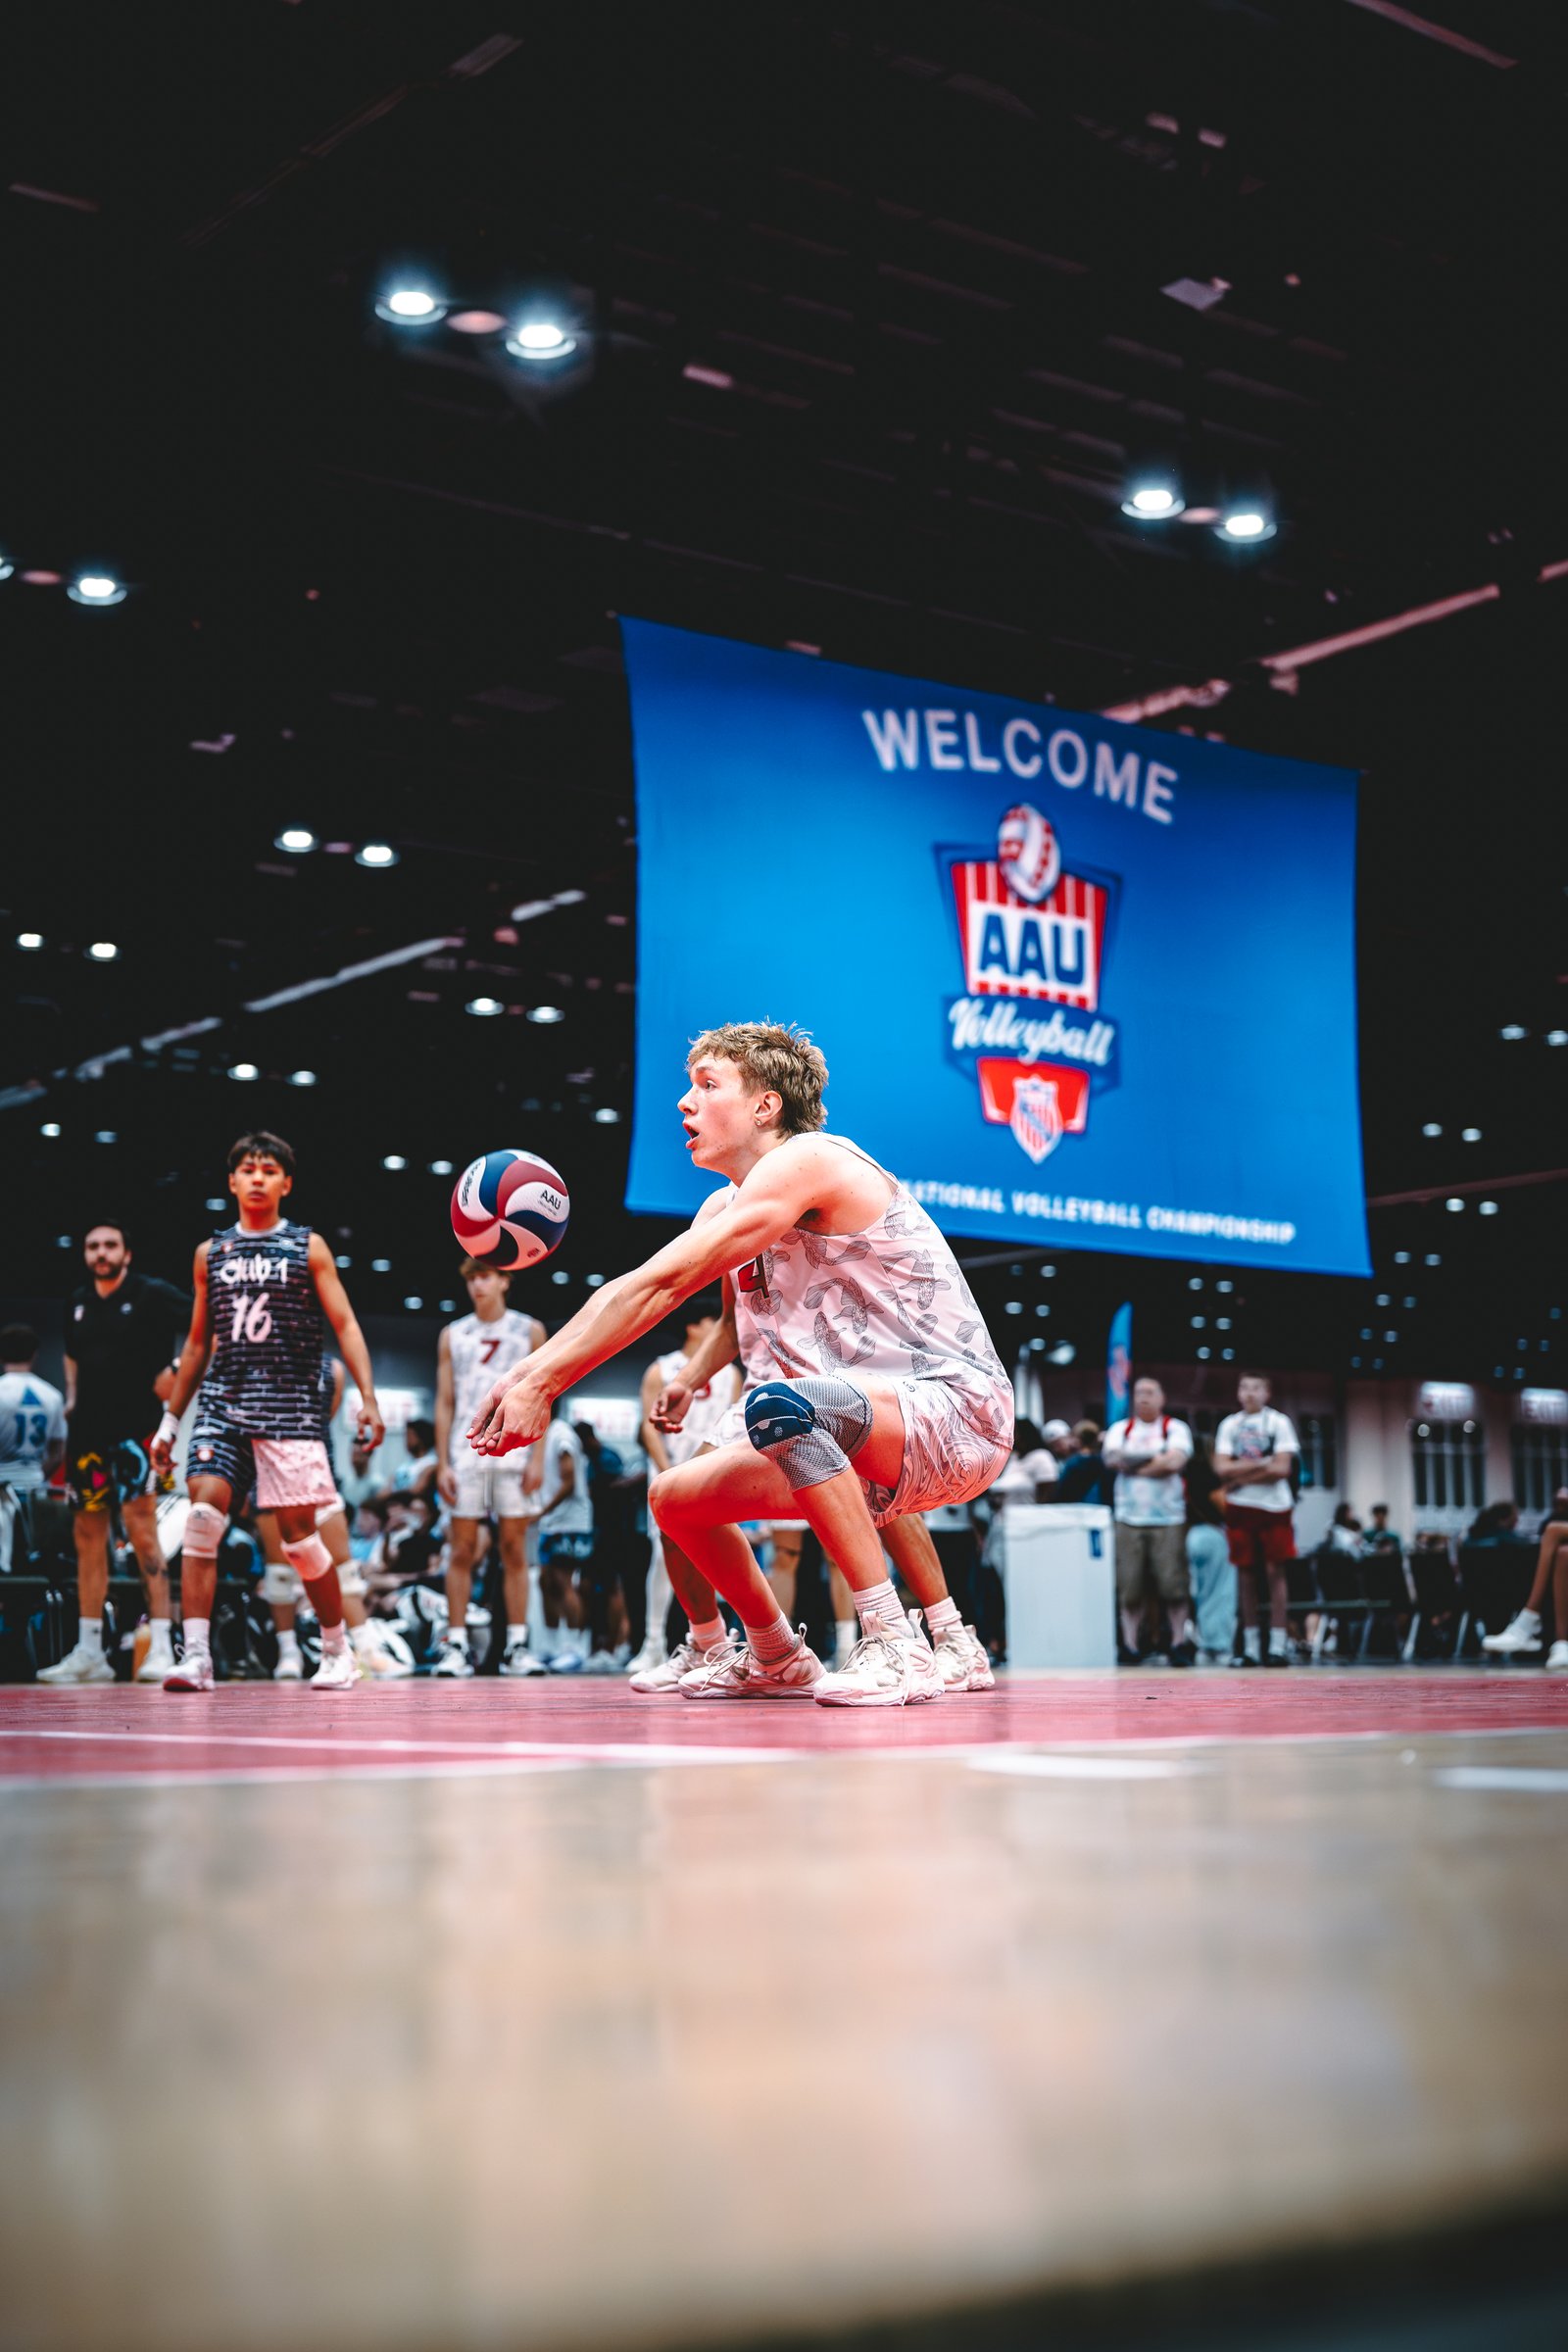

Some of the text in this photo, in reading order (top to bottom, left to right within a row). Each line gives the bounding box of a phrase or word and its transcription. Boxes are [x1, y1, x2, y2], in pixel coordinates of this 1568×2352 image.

[861, 708, 1179, 825] WELCOME
[979, 911, 1086, 987] AAU
[948, 998, 1115, 1065] Volleyball
[540, 1190, 562, 1210] AAU
[1011, 1190, 1143, 1229] VOLLEYBALL
[1146, 1204, 1297, 1246] CHAMPIONSHIP
[230, 1292, 273, 1344] 16
[479, 1339, 502, 1364] 7
[14, 1412, 48, 1447] 13
